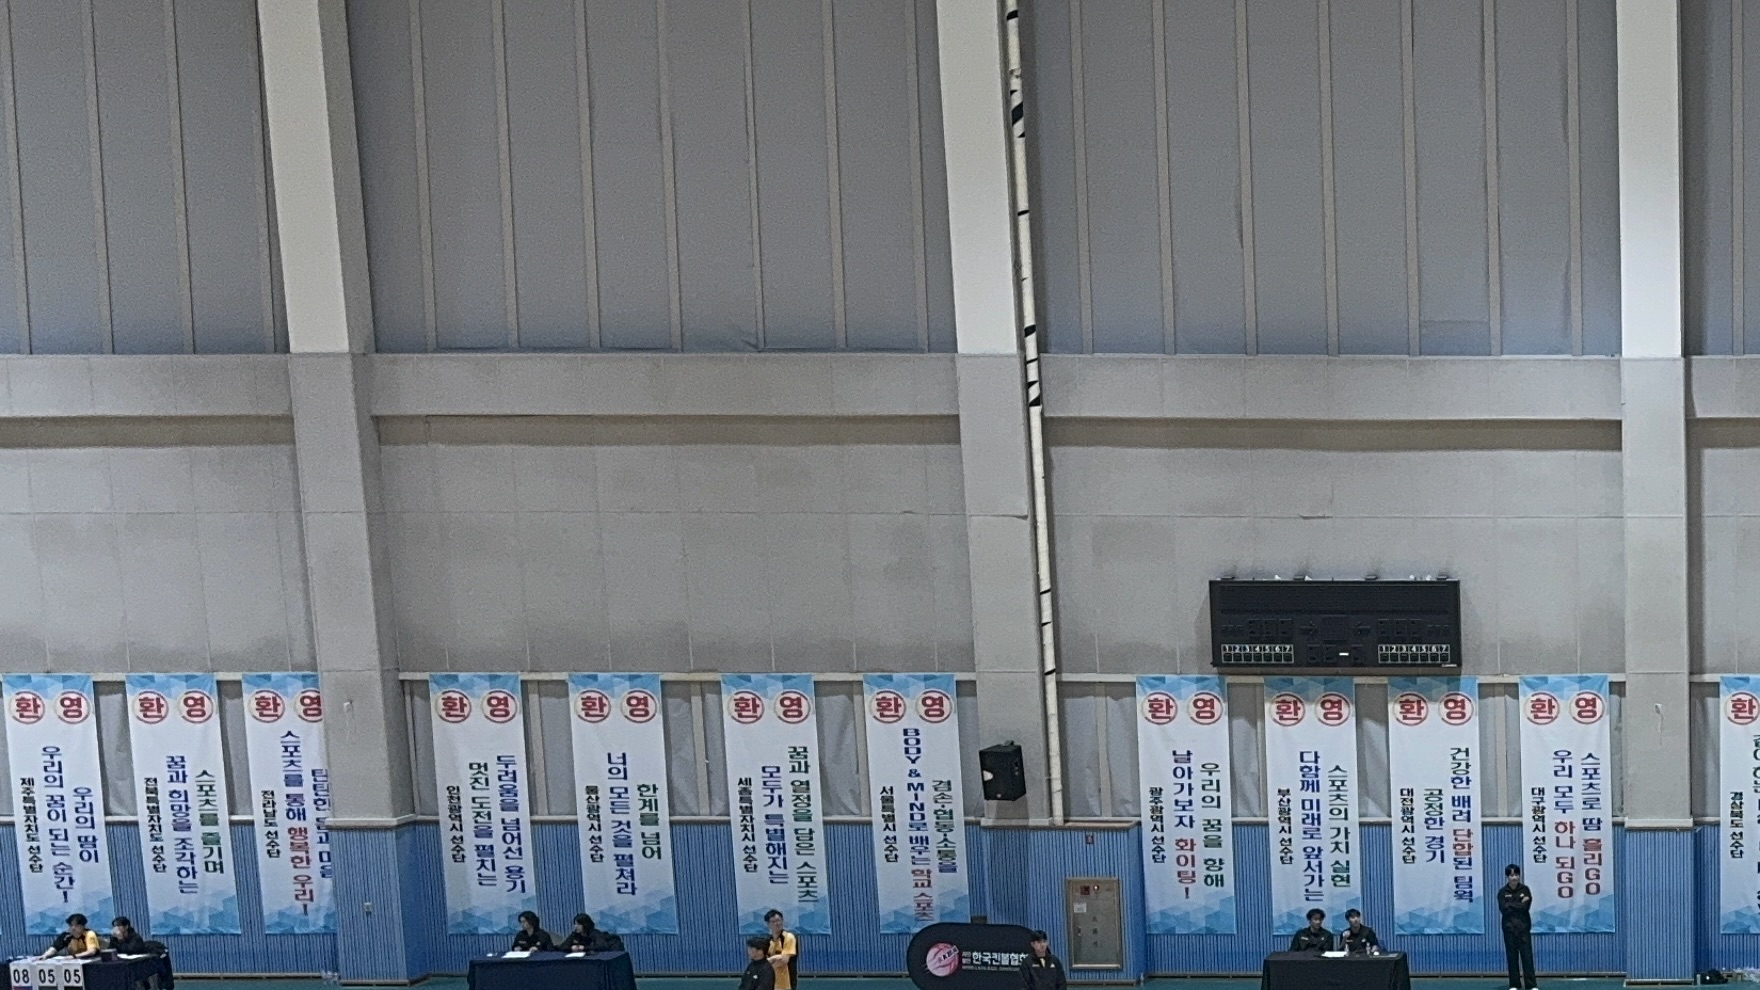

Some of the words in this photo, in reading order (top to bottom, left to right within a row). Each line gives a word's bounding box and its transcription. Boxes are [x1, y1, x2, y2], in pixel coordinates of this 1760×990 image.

[15, 697, 82, 718] 환영
[139, 696, 207, 718] 환영
[442, 696, 510, 717] 환영
[581, 696, 650, 717] 환영
[734, 697, 803, 718] 환영
[875, 696, 945, 718] 환영
[1148, 698, 1216, 719] 환영
[1276, 699, 1344, 721] 환영
[1399, 698, 1466, 720] 환영
[1530, 697, 1597, 719] 환영
[280, 731, 303, 787] 스포츠를
[788, 746, 810, 774] 꿈과
[903, 728, 921, 764] BODY
[41, 746, 63, 789] 우리의
[166, 756, 188, 783] 꿈과
[469, 762, 489, 791] 멋진
[608, 752, 627, 781] 너의
[908, 769, 921, 777] &
[1299, 751, 1321, 794] 다함께
[1450, 748, 1471, 790] 건강한
[1553, 750, 1573, 779] 우리
[496, 755, 520, 812] 두려움을
[761, 766, 784, 808] 모두가
[1172, 750, 1195, 829] 날아가보자
[1200, 763, 1221, 810] 우리의
[1328, 765, 1349, 822] 스포츠의
[1581, 752, 1602, 810] 스포츠로
[20, 778, 40, 842] 제주특별자치도
[46, 795, 66, 822] 꿈이
[73, 787, 95, 830] 우리의
[144, 778, 163, 842] 전북특별자치도
[169, 790, 191, 831] 희망을
[195, 770, 219, 827] 스포츠를
[285, 794, 307, 821] 통해
[447, 786, 463, 832] 인천광역시
[585, 786, 601, 832] 울산광역시
[609, 787, 630, 815] 모든
[637, 784, 659, 827] 한계를
[738, 777, 755, 842] 세종특별자치시
[790, 780, 813, 822] 열정을
[880, 786, 897, 832] 서울특별시
[1149, 787, 1164, 833] 광주광역시
[1277, 789, 1293, 834] 부산광역시
[1400, 788, 1415, 834] 대전광역시
[1424, 789, 1445, 830] 공정한
[1451, 795, 1471, 823] 배려
[1531, 788, 1546, 833] 대구광역시
[1554, 786, 1574, 814] 모두
[1730, 792, 1743, 828] 경상북도
[472, 797, 493, 839] 도전을
[1301, 799, 1322, 840] 미래로
[1583, 818, 1602, 831] 땀
[49, 829, 70, 856] 되는
[265, 830, 280, 858] 선수단
[288, 827, 311, 869] 행복한
[501, 818, 523, 860] 넘어선
[611, 820, 633, 848] 것을
[641, 832, 662, 860] 넘어
[794, 828, 815, 856] 담은
[1202, 819, 1223, 848] 꿈을
[1329, 827, 1351, 854] 가치
[1555, 821, 1576, 849] 하나
[1730, 831, 1743, 858] 선수단
[29, 845, 43, 873] 선수단
[78, 836, 99, 863] 땀이
[151, 845, 167, 873] 선수단
[202, 833, 224, 874] 즐기며
[450, 836, 466, 863] 선수단
[589, 836, 604, 863] 선수단
[743, 845, 758, 873] 선수단
[764, 815, 788, 884] 특별해지는
[884, 836, 898, 863] 선수단
[909, 836, 930, 866] 배우는
[1151, 836, 1166, 863] 선수단
[1279, 837, 1293, 864] 선수단
[1401, 837, 1416, 864] 선수단
[1425, 837, 1445, 863] 경기
[1452, 828, 1473, 870] 단합된
[1533, 836, 1547, 863] 선수단
[174, 838, 199, 894] 조각하는
[474, 845, 497, 887] 펼치는
[505, 866, 526, 893] 용기
[614, 854, 637, 896] 펼쳐라
[911, 869, 932, 889] 학교
[1175, 838, 1196, 899] 화이팅!
[1203, 858, 1224, 888] 향해
[1303, 847, 1324, 902] 앞서가는
[1330, 860, 1351, 888] 실현
[53, 862, 74, 903] 순간!
[293, 875, 314, 916] 우리!
[796, 862, 818, 902] 스포츠
[913, 892, 934, 922] 스포츠
[13, 969, 30, 984] 08
[38, 969, 55, 984] 05
[63, 969, 81, 984] 05
